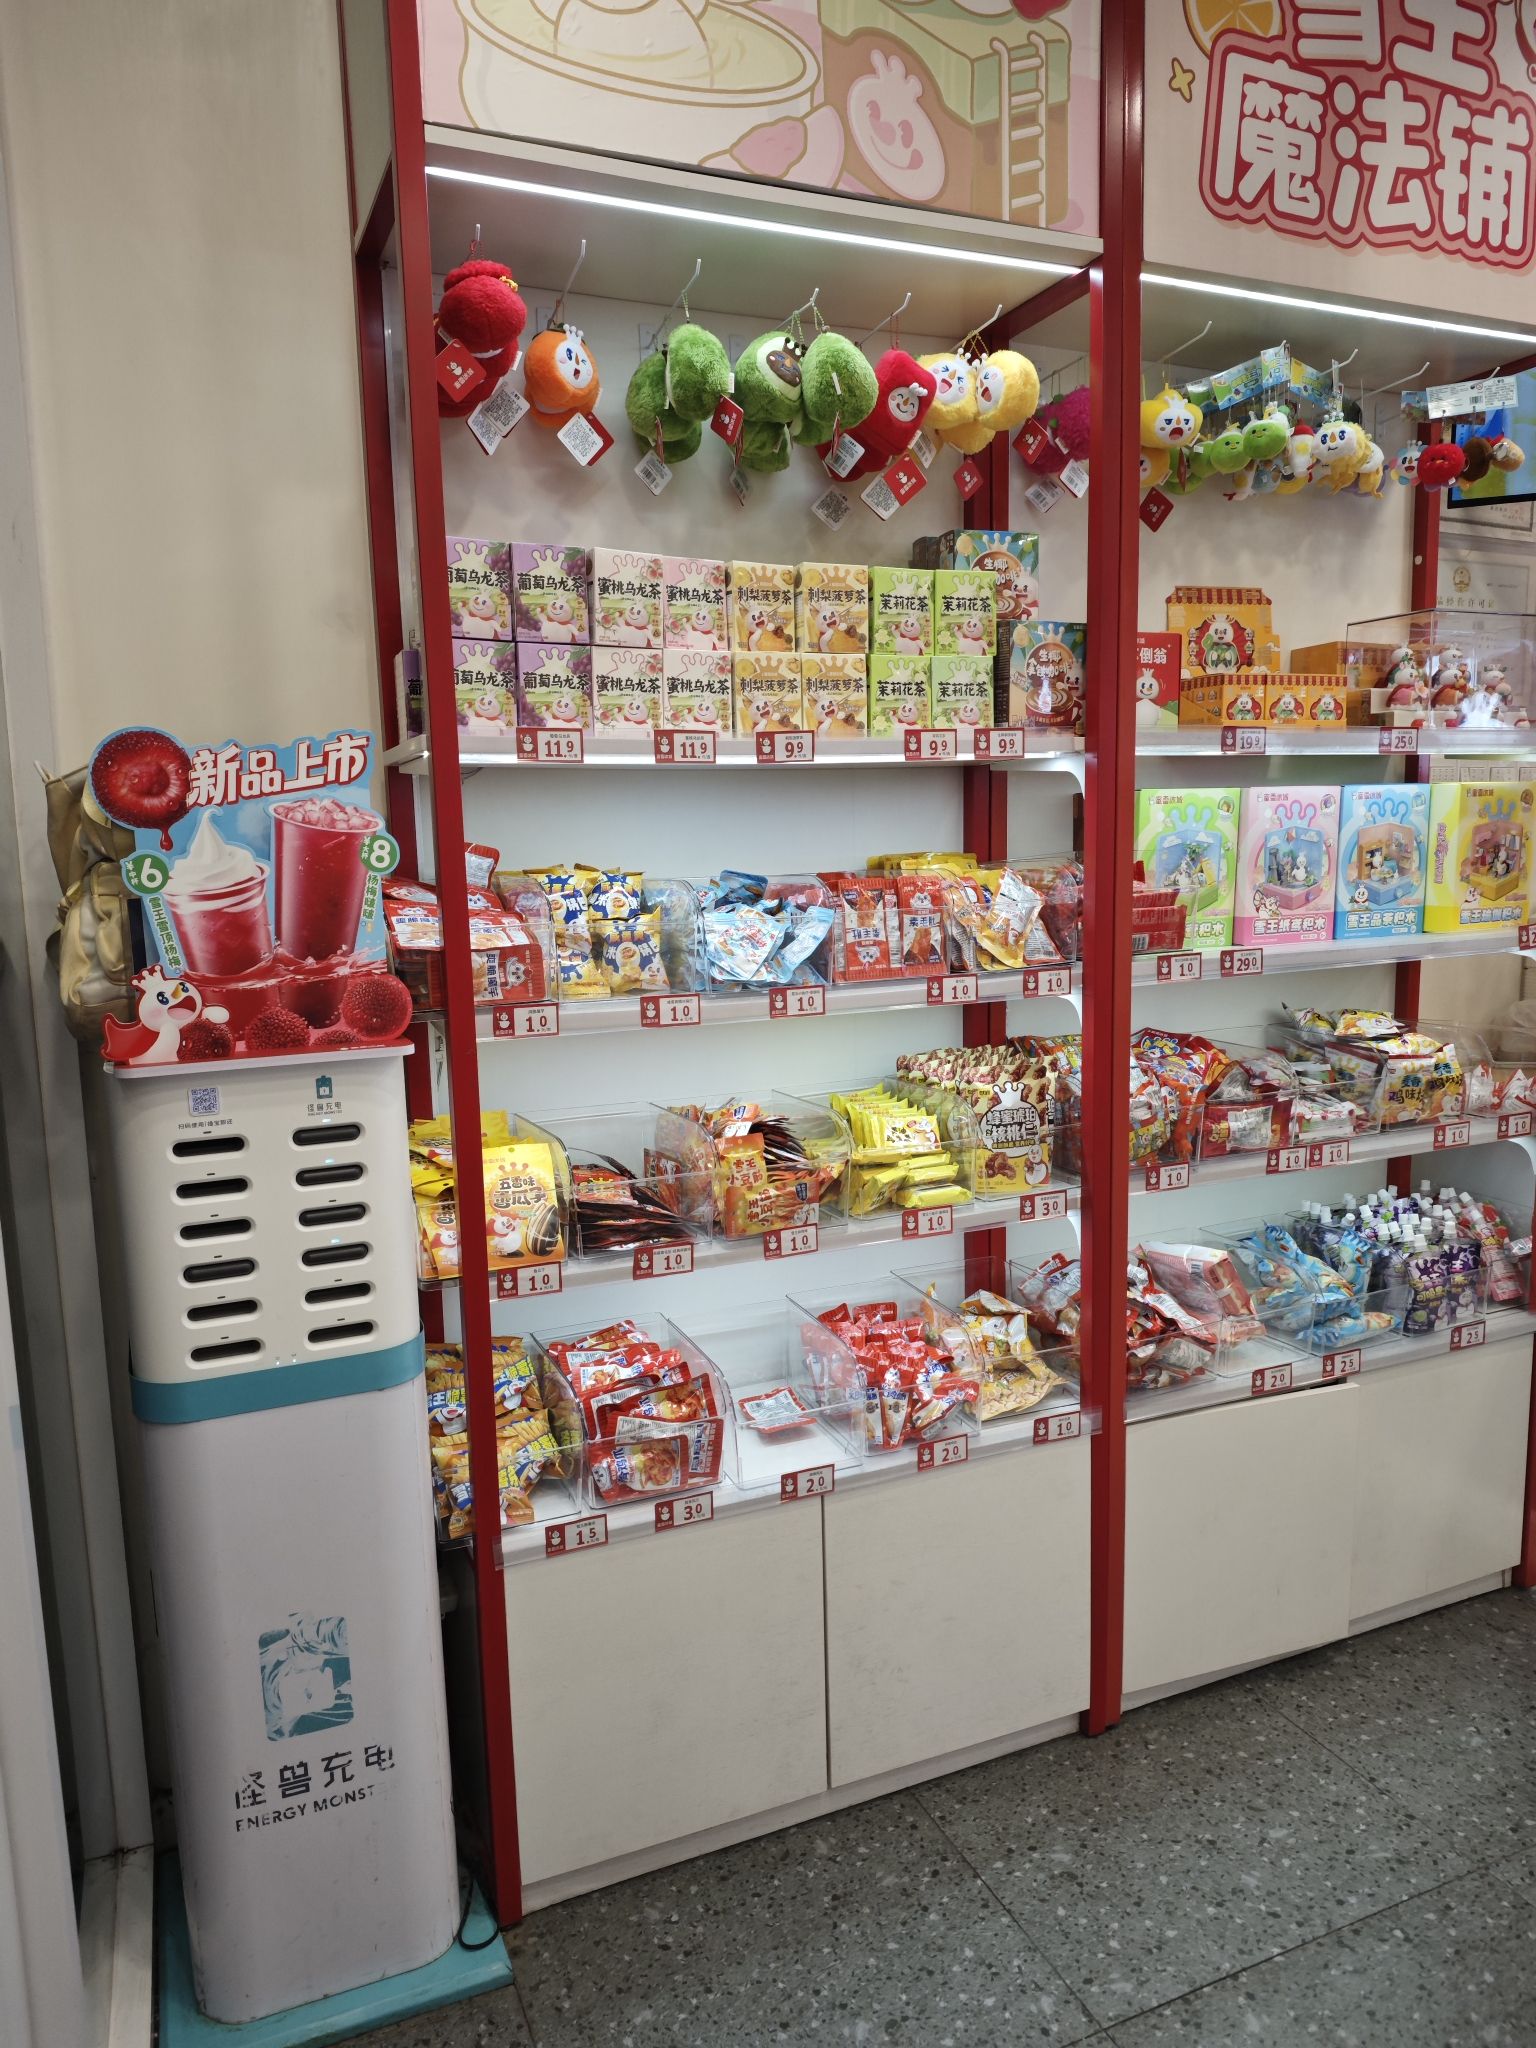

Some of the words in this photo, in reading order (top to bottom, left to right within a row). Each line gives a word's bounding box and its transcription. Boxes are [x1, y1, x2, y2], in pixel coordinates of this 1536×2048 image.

[1214, 52, 1528, 252] 魔法铺
[517, 572, 584, 593] 葡萄乌龙茶
[597, 576, 661, 600] 蜜桃乌龙茶
[666, 584, 724, 605] 蜜桃乌龙茶
[737, 586, 791, 605] 刺梨菠萝茶
[808, 586, 866, 605] 刺梨菠萝茶
[880, 593, 928, 612] 茉莉花茶
[942, 595, 991, 612] 茉莉花茶
[1137, 647, 1167, 665] 倒翁
[522, 671, 589, 692] 葡萄乌龙茶
[596, 674, 661, 695] 蜜桃乌龙茶
[666, 676, 730, 696] 蜜桃乌龙茶
[740, 677, 798, 694] 刺梨菠萝茶
[805, 677, 864, 694] 刺梨菠萝茶
[877, 680, 926, 697] 茉莉花茶
[938, 681, 988, 698] 茉莉花茶
[545, 740, 574, 758] 11.9
[680, 741, 707, 759] 11.9
[785, 741, 804, 758] 9.9
[930, 740, 947, 756] 9.9
[999, 738, 1015, 754] 9.9
[187, 734, 370, 806] 新品上市
[369, 839, 391, 869] 8
[141, 858, 163, 888] 6
[1347, 910, 1416, 928] 雪王品茶积木
[148, 897, 182, 969] 雪王雪顶杨梅
[952, 985, 968, 999] 1.0
[1047, 977, 1062, 992] 1.0
[797, 996, 814, 1011] 1.0
[670, 1005, 690, 1021] 1.0
[526, 1015, 547, 1032] 1.0
[986, 1108, 1037, 1126] 蜂蜜琥珀
[499, 1176, 535, 1190] 五香味
[1042, 1200, 1058, 1216] 3.0
[928, 1215, 943, 1230] 1.0
[791, 1235, 808, 1251] 1.0
[664, 1254, 682, 1270] 1.0
[528, 1274, 549, 1291] 1.0
[1057, 1421, 1072, 1436] 1.0
[942, 1445, 959, 1462] 2.0
[807, 1476, 824, 1494] 2.0
[684, 1503, 702, 1520] 3.0
[576, 1527, 596, 1545] 1.5
[235, 1744, 395, 1809] 怪兽充电
[235, 1803, 306, 1832] ENERGY
[313, 1782, 386, 1812] MONST
